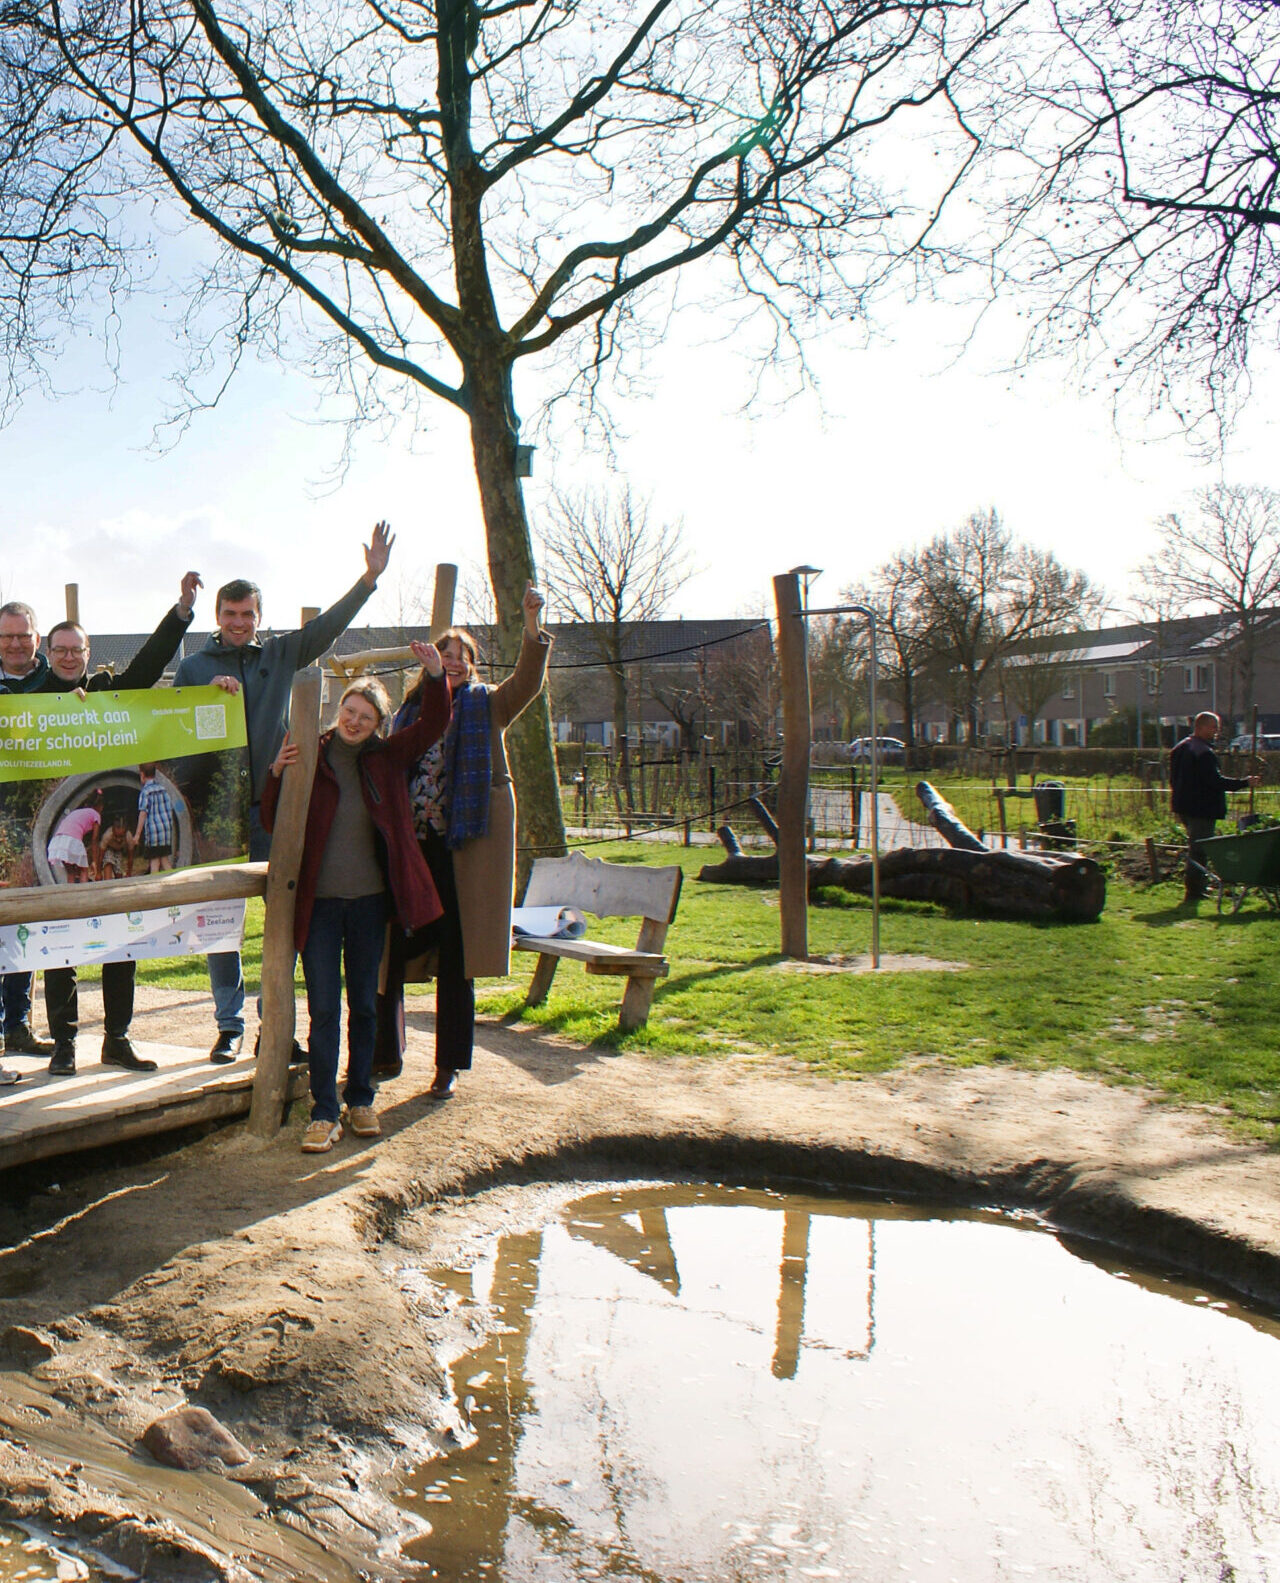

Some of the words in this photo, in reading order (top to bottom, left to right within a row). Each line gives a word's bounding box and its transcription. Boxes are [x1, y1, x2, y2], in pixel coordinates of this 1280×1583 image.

[38, 709, 100, 733] gewerkt
[104, 709, 131, 725] aan
[46, 729, 138, 752] schoolplein!
